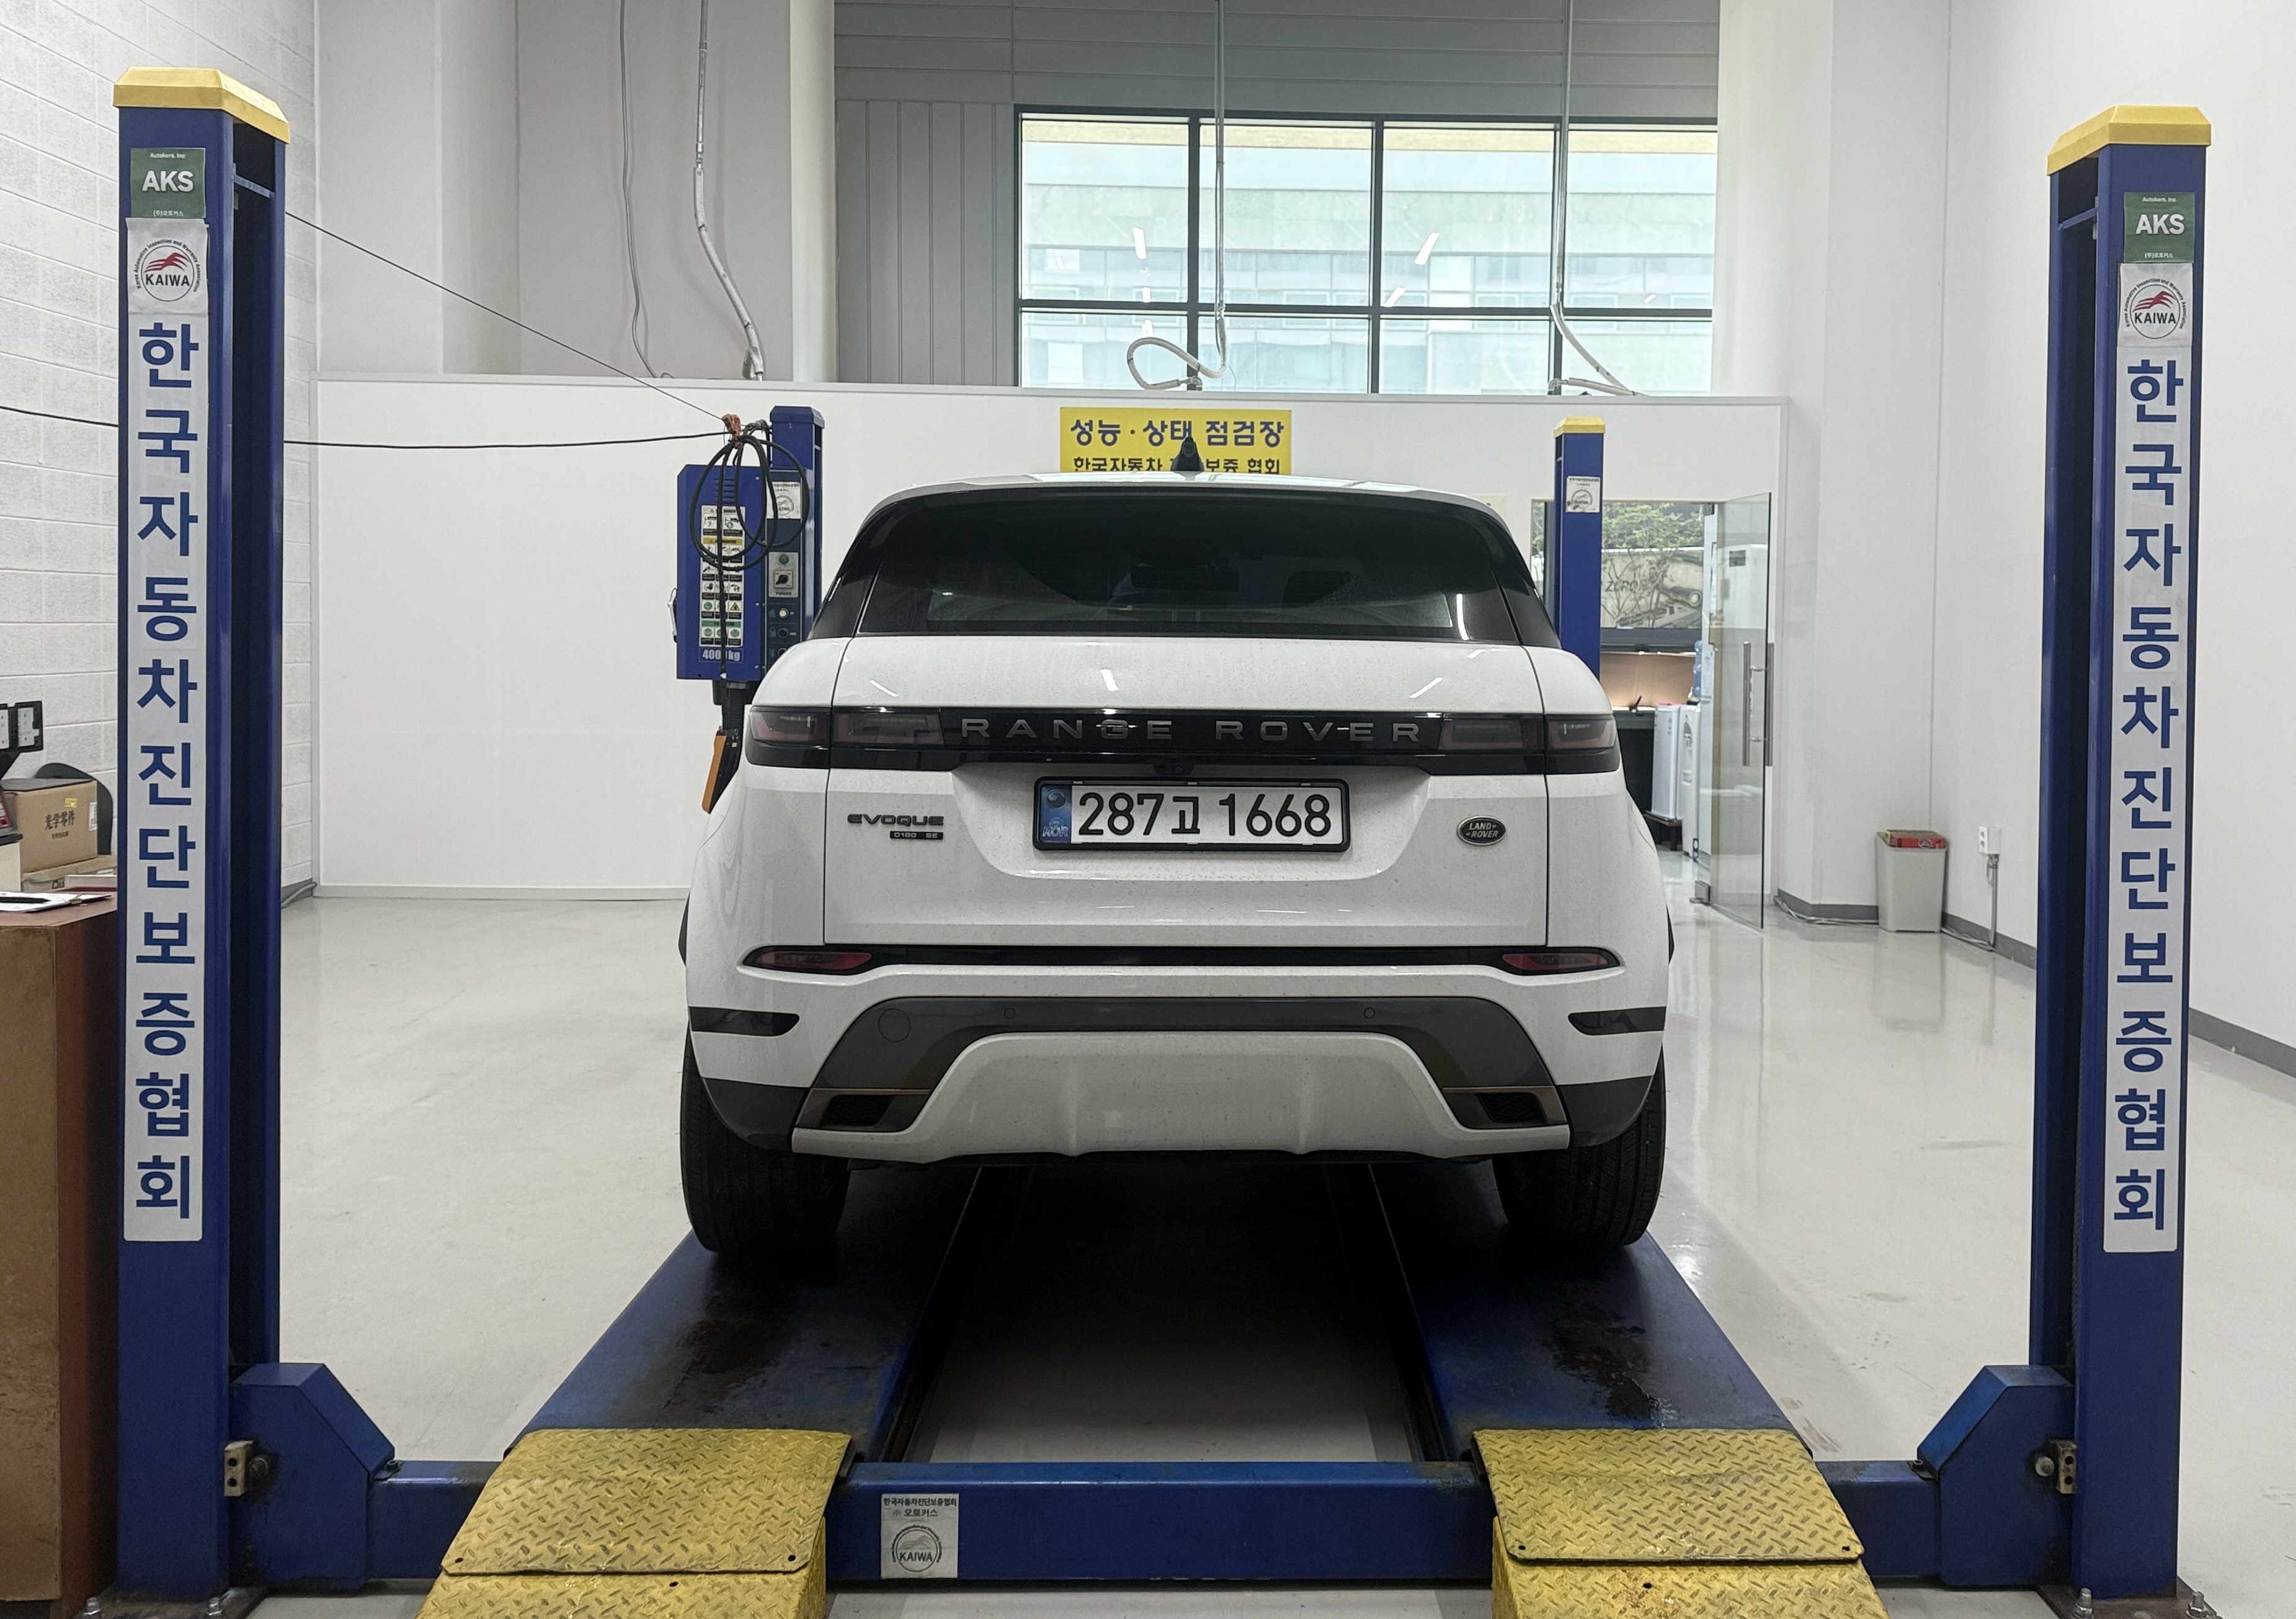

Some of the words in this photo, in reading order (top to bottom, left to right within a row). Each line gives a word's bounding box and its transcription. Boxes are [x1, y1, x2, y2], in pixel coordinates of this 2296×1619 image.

[142, 171, 194, 192] AKS
[2135, 214, 2184, 234] AKS
[146, 274, 190, 286] KAIWA
[2135, 312, 2176, 324] KAIWA
[1206, 421, 1284, 447] 점검장
[1074, 457, 1163, 471] 한국자동차
[1247, 458, 1280, 474] 협회
[702, 649, 740, 661] 400kg
[961, 718, 1173, 740] RANGE
[1215, 720, 1420, 742] ROVER
[135, 323, 199, 1220] 한국자동차진단보증협회
[2114, 359, 2184, 1230] 한국자동차진단보증협회
[847, 814, 944, 826] EVOQUE
[1079, 792, 1200, 836] 287고
[1219, 793, 1332, 837] 1668
[1042, 826, 1069, 837] KOR
[1471, 830, 1498, 838] ROVER
[883, 1497, 957, 1507] 한국자동차진단보증협회
[904, 1509, 938, 1517] 오토커스
[900, 1552, 933, 1562] KAIWA
